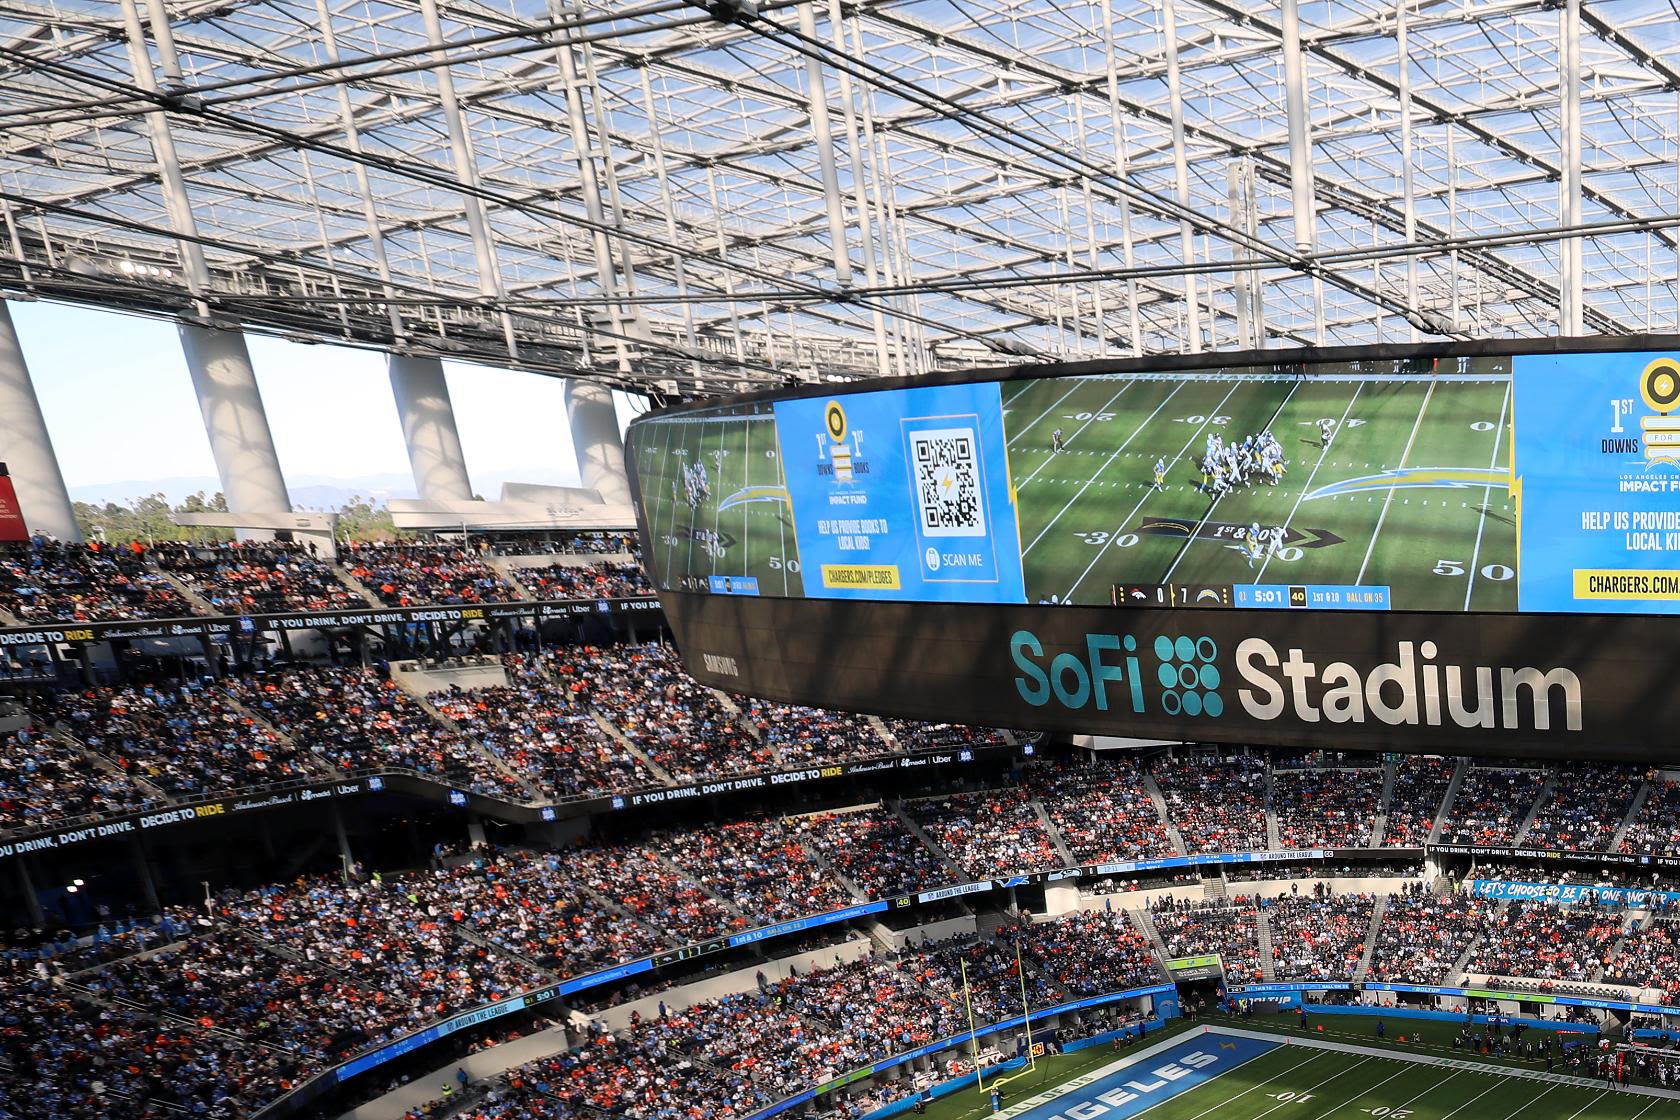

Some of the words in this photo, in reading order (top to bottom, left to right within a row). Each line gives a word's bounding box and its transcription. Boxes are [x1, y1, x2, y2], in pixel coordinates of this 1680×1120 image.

[1610, 398, 1634, 433] 1ST
[1601, 438, 1638, 454] DOWNS
[1620, 480, 1667, 492] IMPACT
[817, 521, 830, 535] HELP
[830, 520, 839, 535] US
[839, 520, 861, 534] PROVIDE
[861, 520, 879, 534] BOOKS
[879, 519, 888, 534] TO
[1581, 511, 1610, 530] HELP
[1613, 512, 1629, 530] US
[838, 536, 855, 550] LOCAL
[1084, 531, 1139, 547] 30
[1626, 532, 1663, 551] LOCAL
[942, 553, 966, 567] SCAN
[968, 553, 983, 566] ME
[828, 569, 893, 585] CHARGERS.COM/PLEDGES
[1432, 559, 1515, 581] 50
[1157, 587, 1164, 603] 0
[1181, 587, 1188, 603] 7
[1255, 591, 1282, 603] 5:01
[1292, 591, 1304, 602] 40
[1375, 592, 1383, 603] 35
[269, 619, 279, 629] IF
[281, 618, 303, 629] YOU
[305, 616, 340, 627] DRINK,
[342, 615, 373, 625] DON'T
[374, 613, 406, 624] DRIVE.
[411, 611, 448, 621] DECIDE
[448, 611, 461, 620] TO
[462, 608, 484, 619] RIDE
[1010, 630, 1146, 713] SoFi
[1235, 637, 1583, 731] Stadium
[932, 755, 951, 765] Uber
[632, 795, 642, 805] IF
[643, 791, 665, 804] YOU
[666, 787, 701, 801] DRINK,
[702, 781, 733, 794] DON'T
[735, 777, 766, 790] DRIVE.
[770, 771, 805, 785] DECIDE
[805, 769, 820, 780] TO
[820, 766, 843, 778] RIDE
[999, 1098, 1031, 1118] ALL
[1036, 1087, 1064, 1102] OF
[1065, 1074, 1094, 1089] US
